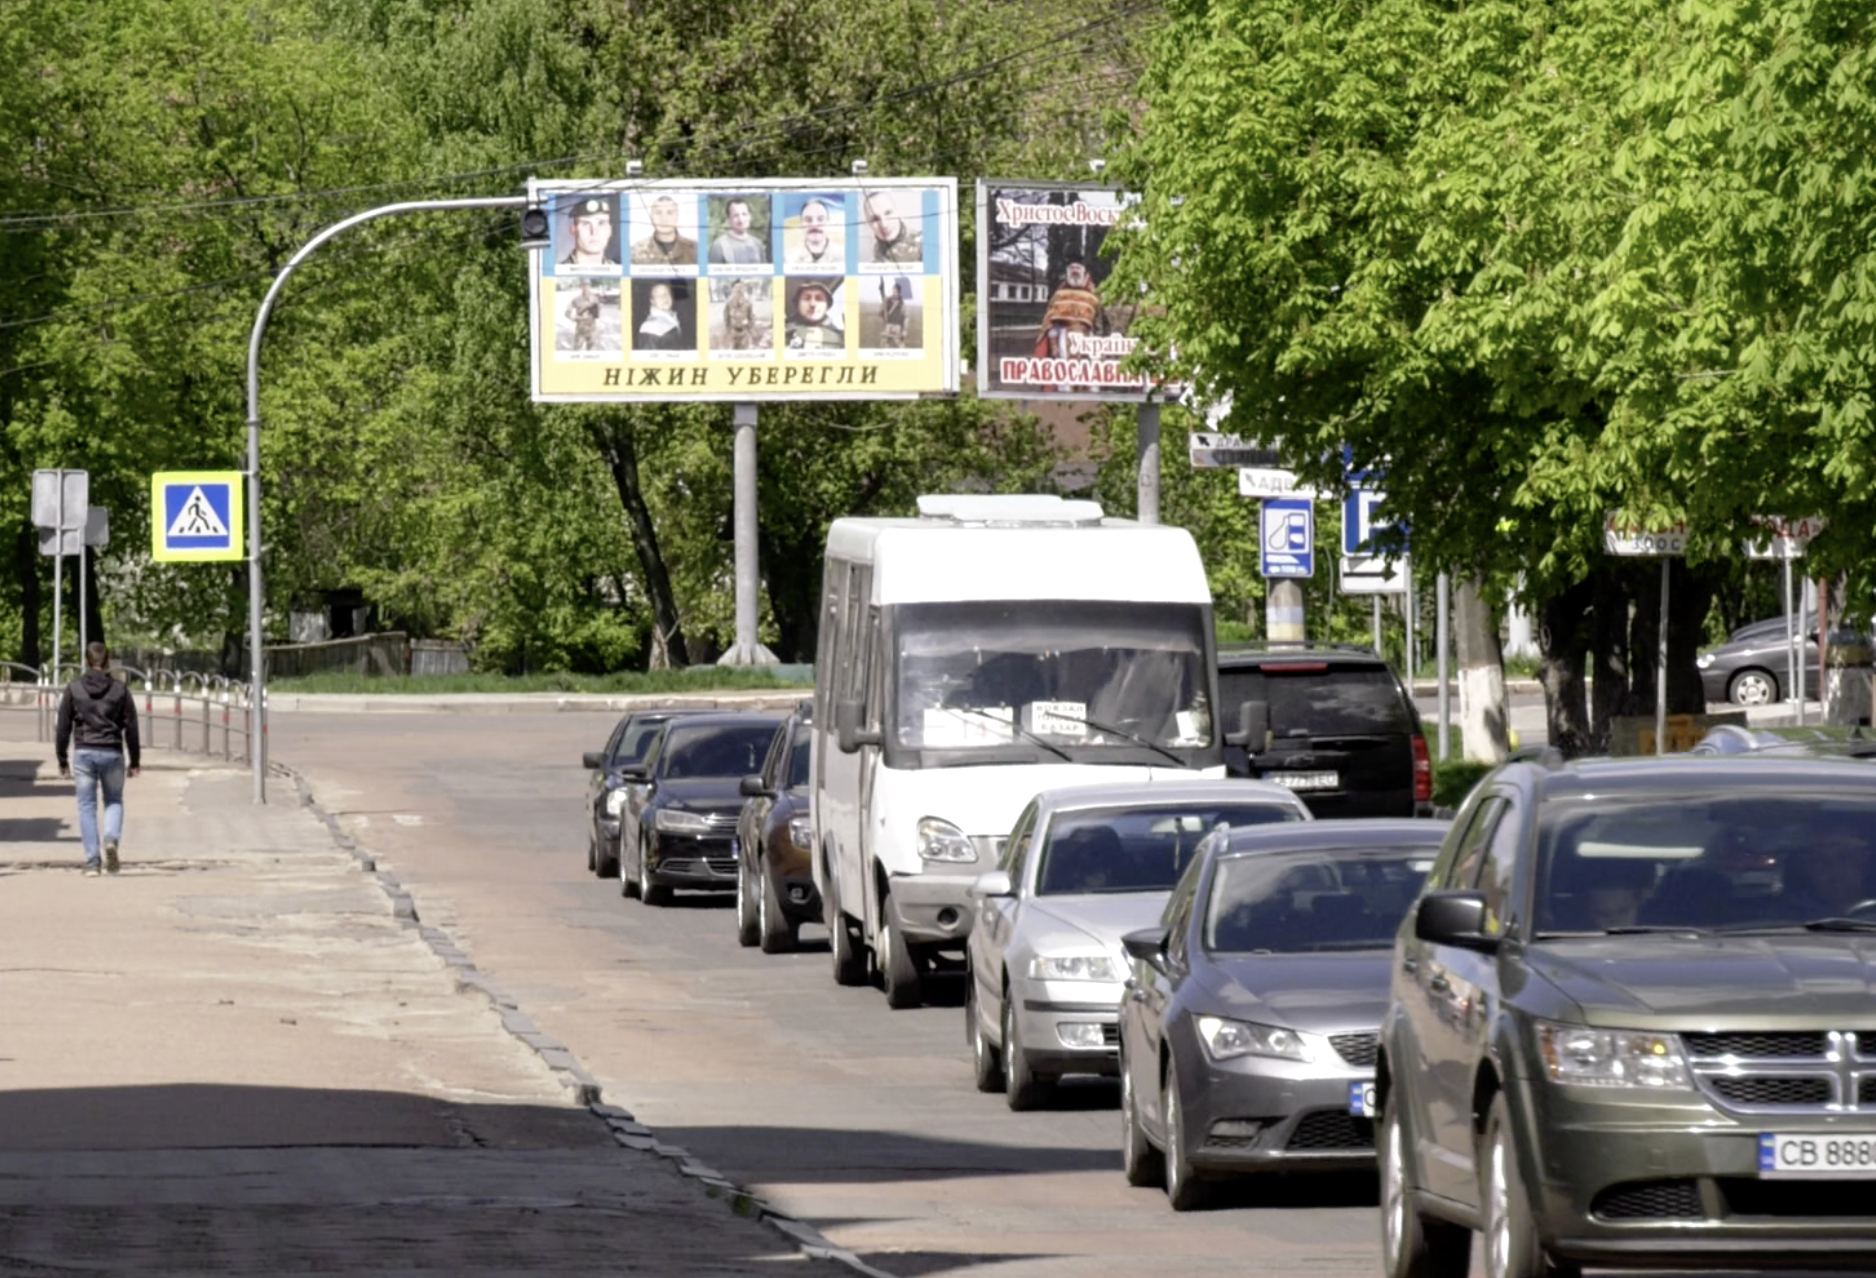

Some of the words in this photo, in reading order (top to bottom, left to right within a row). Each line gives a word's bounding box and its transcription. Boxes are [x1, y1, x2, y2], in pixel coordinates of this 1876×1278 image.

[602, 367, 708, 386] НІЖИН
[727, 365, 879, 385] УБЕРЕГЛИ
[1826, 1141, 1876, 1166] 888
